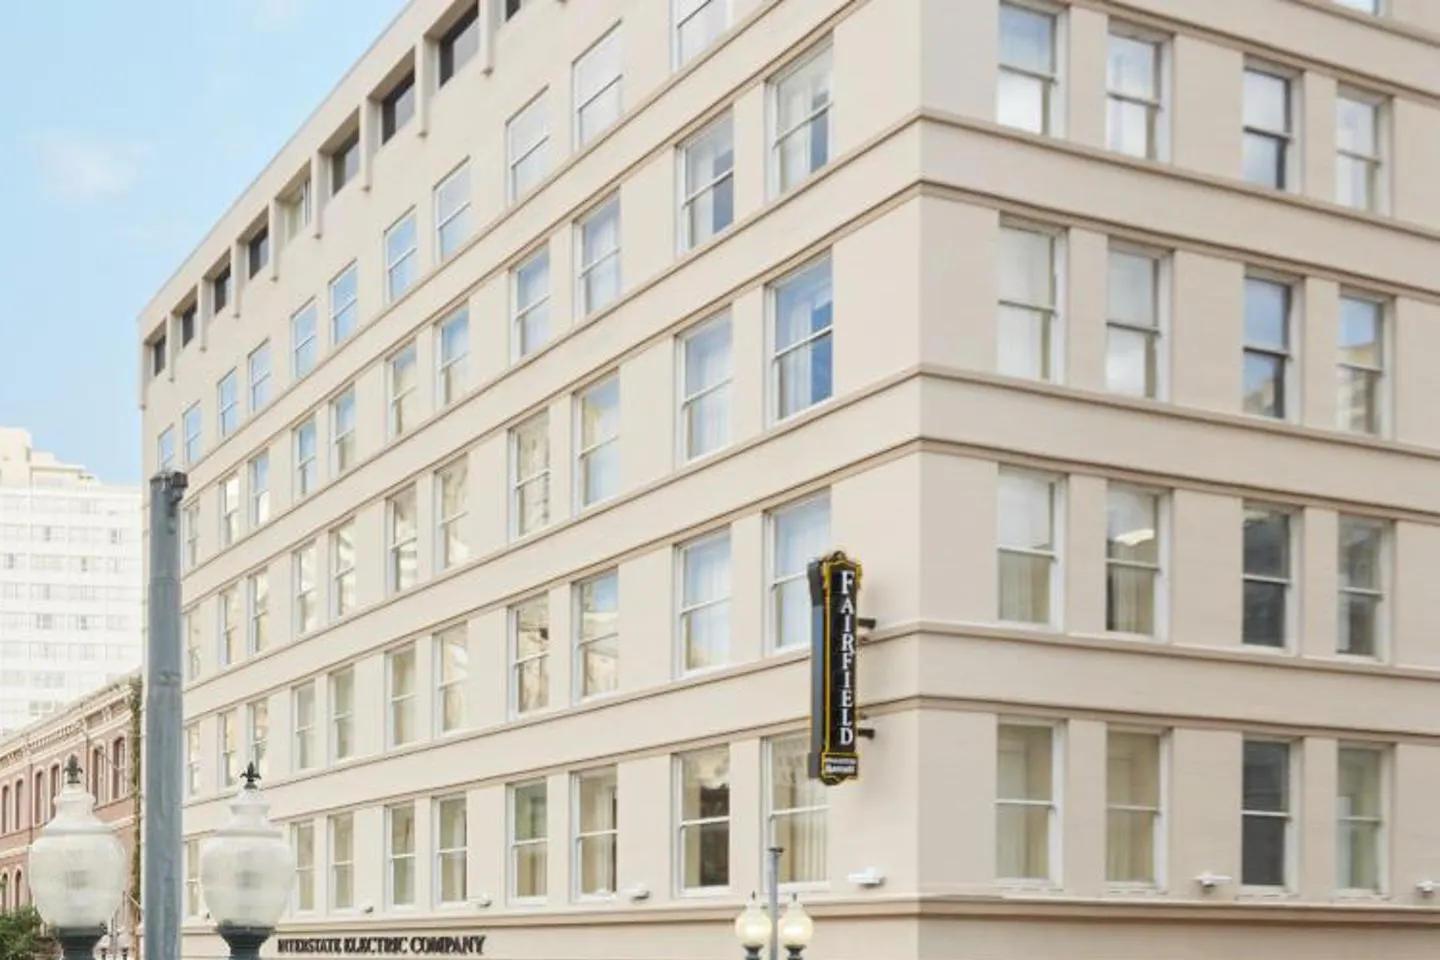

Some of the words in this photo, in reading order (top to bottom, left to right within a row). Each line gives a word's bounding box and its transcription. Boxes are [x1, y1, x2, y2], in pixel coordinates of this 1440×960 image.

[840, 569, 856, 746] FAIRFIELD
[277, 938, 342, 954] INTERSTATE
[343, 936, 408, 954] ELECTRIC
[410, 934, 486, 955] COMPANY
